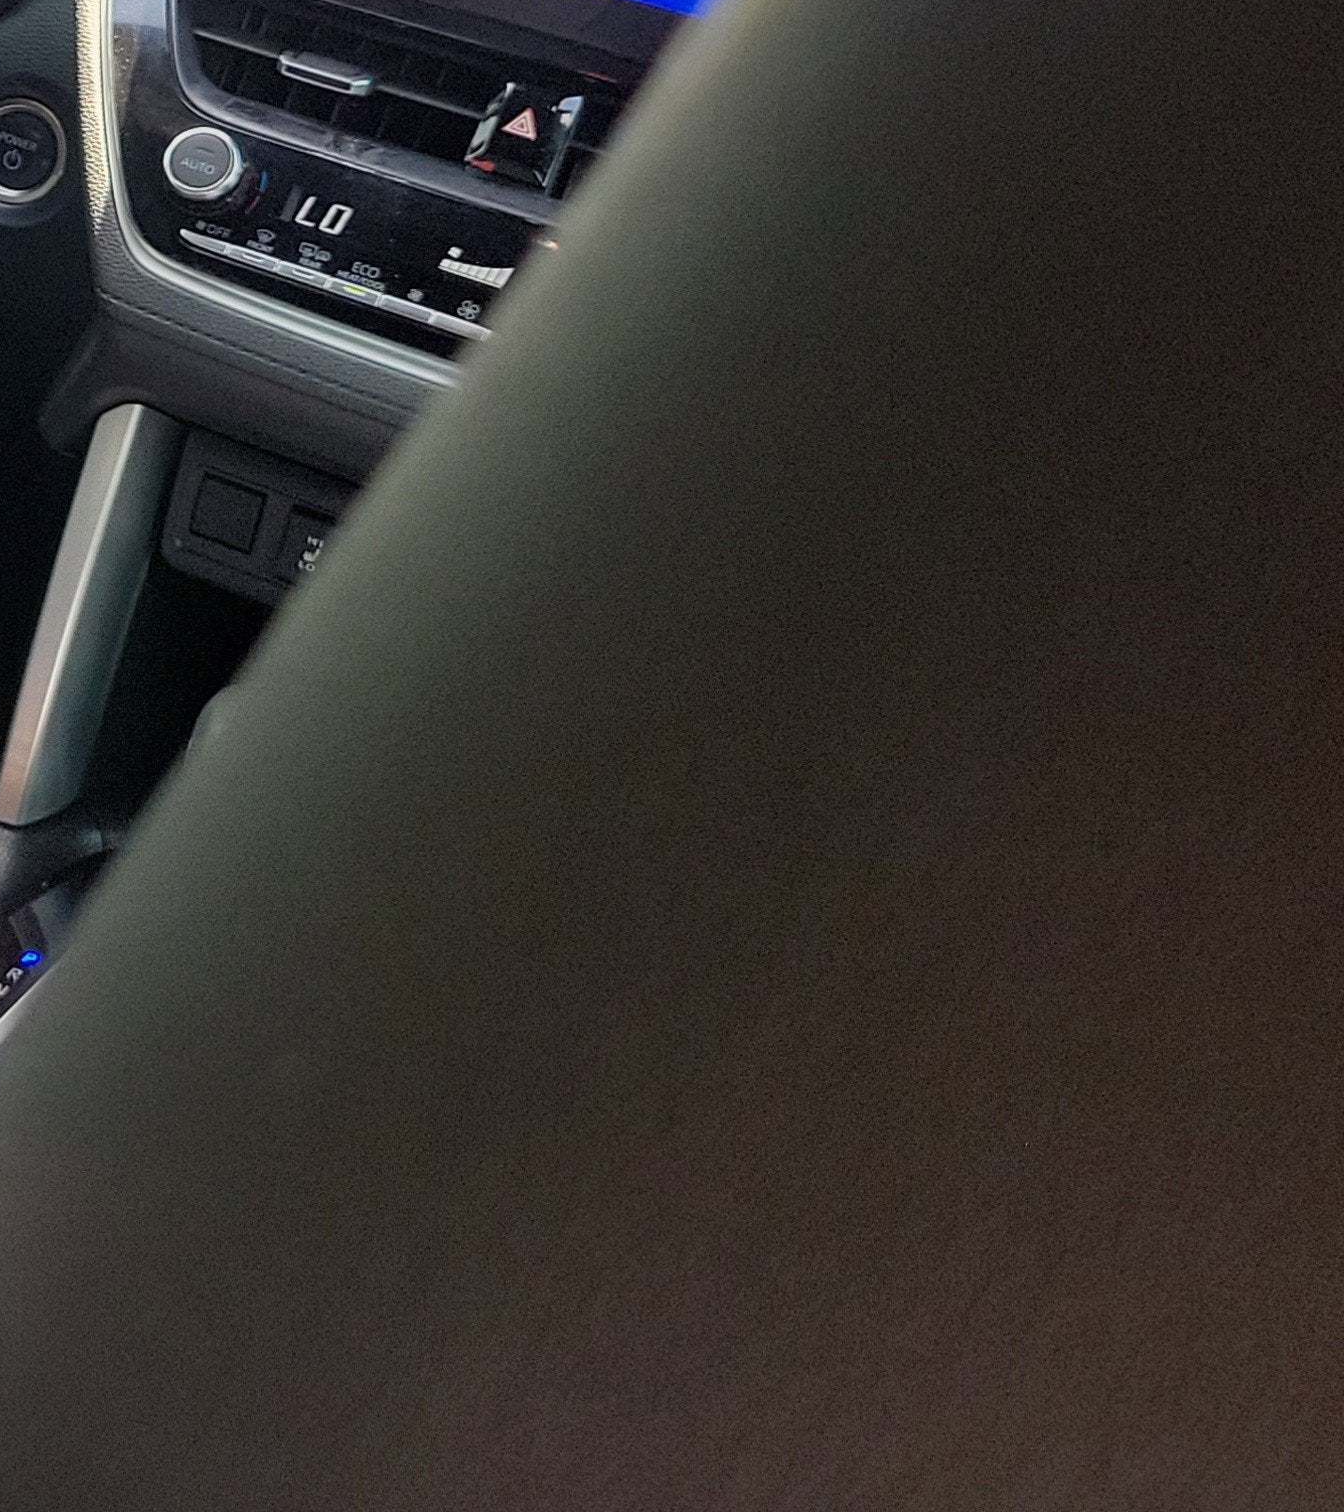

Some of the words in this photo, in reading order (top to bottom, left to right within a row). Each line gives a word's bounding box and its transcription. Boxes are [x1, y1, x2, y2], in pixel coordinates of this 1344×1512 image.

[180, 157, 215, 175] AUTO
[294, 195, 355, 236] LO
[206, 223, 231, 239] OFF
[351, 261, 382, 279] ECO
[5, 967, 24, 984] R
